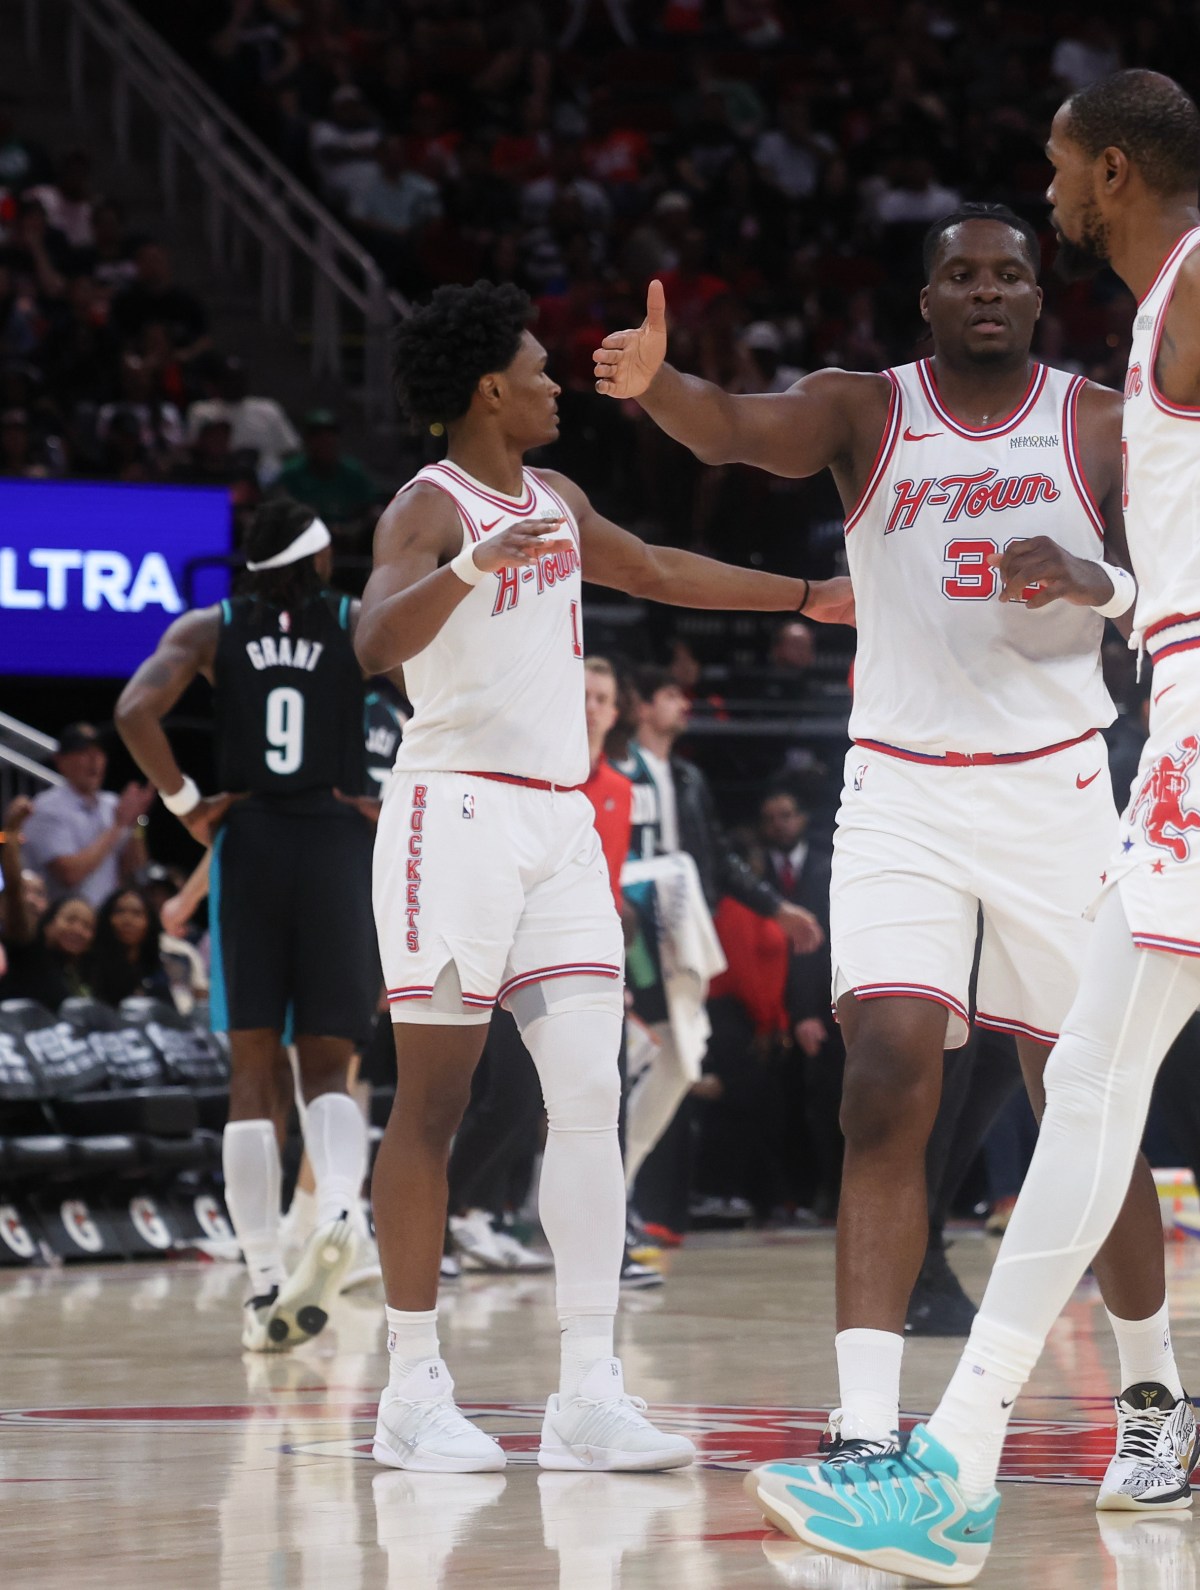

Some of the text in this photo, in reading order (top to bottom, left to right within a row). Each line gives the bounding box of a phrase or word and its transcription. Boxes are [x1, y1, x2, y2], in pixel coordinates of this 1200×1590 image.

[884, 467, 1061, 535] H-Town
[942, 537, 1049, 603] 3
[245, 636, 324, 671] GRANT
[265, 686, 304, 775] 9
[405, 784, 427, 952] ROCKETS
